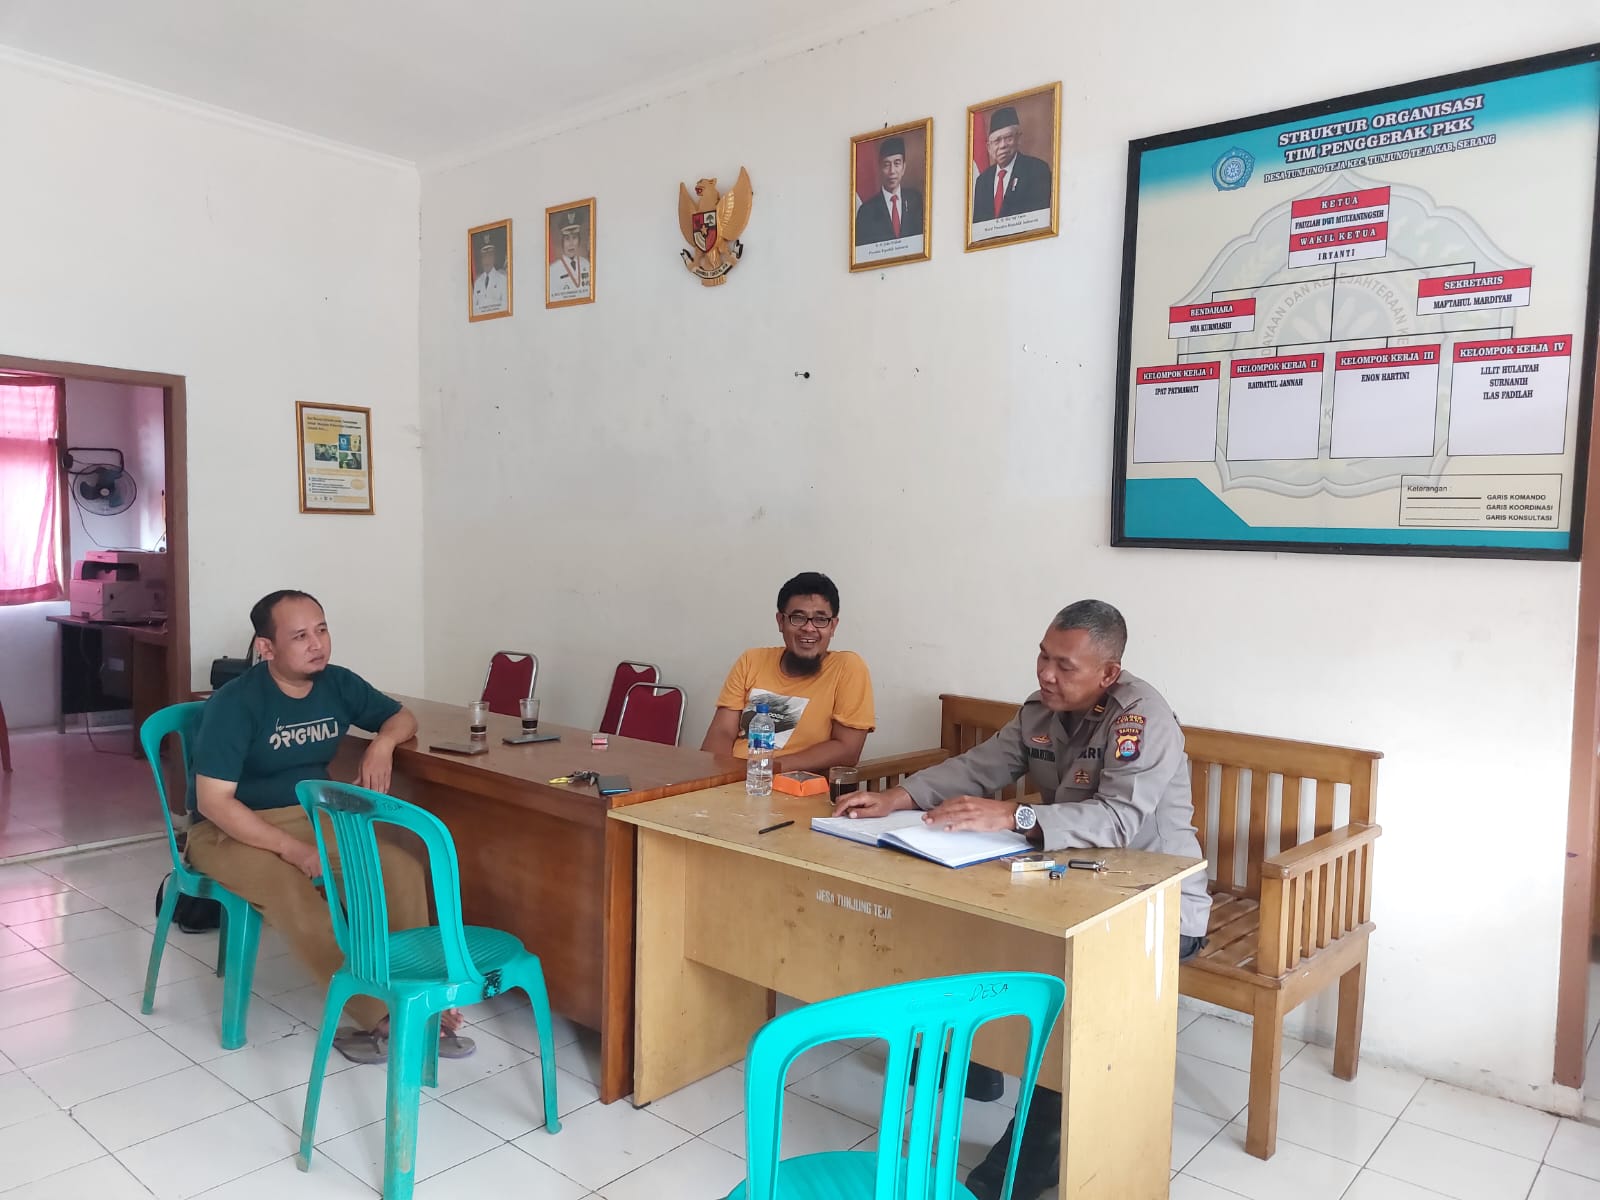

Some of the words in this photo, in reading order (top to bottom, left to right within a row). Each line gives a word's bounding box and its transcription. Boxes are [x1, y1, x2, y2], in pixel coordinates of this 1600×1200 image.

[1278, 117, 1369, 147] STRUKTUR
[1371, 94, 1485, 129] ORGANISASI
[1284, 145, 1318, 163] TIM
[1319, 124, 1429, 157] PENGGERAK
[1430, 116, 1475, 138] PKK
[1264, 171, 1286, 183] DESA
[1286, 164, 1324, 179] TUNJUNG
[1324, 159, 1346, 174] TEJA
[1346, 156, 1367, 169] KEC.
[1367, 150, 1410, 165] TUNJUNG
[1410, 144, 1436, 159] TEJA
[1456, 134, 1497, 150] SERANG
[1320, 195, 1359, 209] KETUA
[1321, 215, 1335, 226] DWI
[1299, 233, 1335, 246] WAKIL
[1338, 227, 1377, 241] KETUA
[1318, 248, 1356, 260] IRYANTI
[1443, 275, 1505, 290] SEKRETARIS
[1433, 296, 1472, 310] MAFTAHUL
[1473, 293, 1513, 306] MARDIYAH
[1190, 304, 1234, 317] BENDAHARA
[1460, 345, 1515, 358] KELOMPOK
[1516, 342, 1550, 354] KERJA
[1553, 341, 1566, 352] IV
[1236, 362, 1280, 374] KELOMPOK
[1281, 359, 1307, 370] KERJA
[1310, 358, 1318, 368] II
[1340, 354, 1390, 366] KELOMPOK
[1390, 351, 1420, 362] KERJA
[1423, 350, 1435, 360] III
[1143, 370, 1182, 380] KELOMPOK
[1183, 367, 1207, 378] KERJA
[1360, 372, 1380, 383] ENON
[1381, 370, 1411, 382] HARTINI
[1502, 363, 1540, 375] HULAIYAH
[1508, 514, 1553, 522] KONSULTASI
[268, 720, 339, 751] ORIGINAL
[837, 894, 872, 915] TUNJUNG
[873, 903, 893, 919] TEJA
